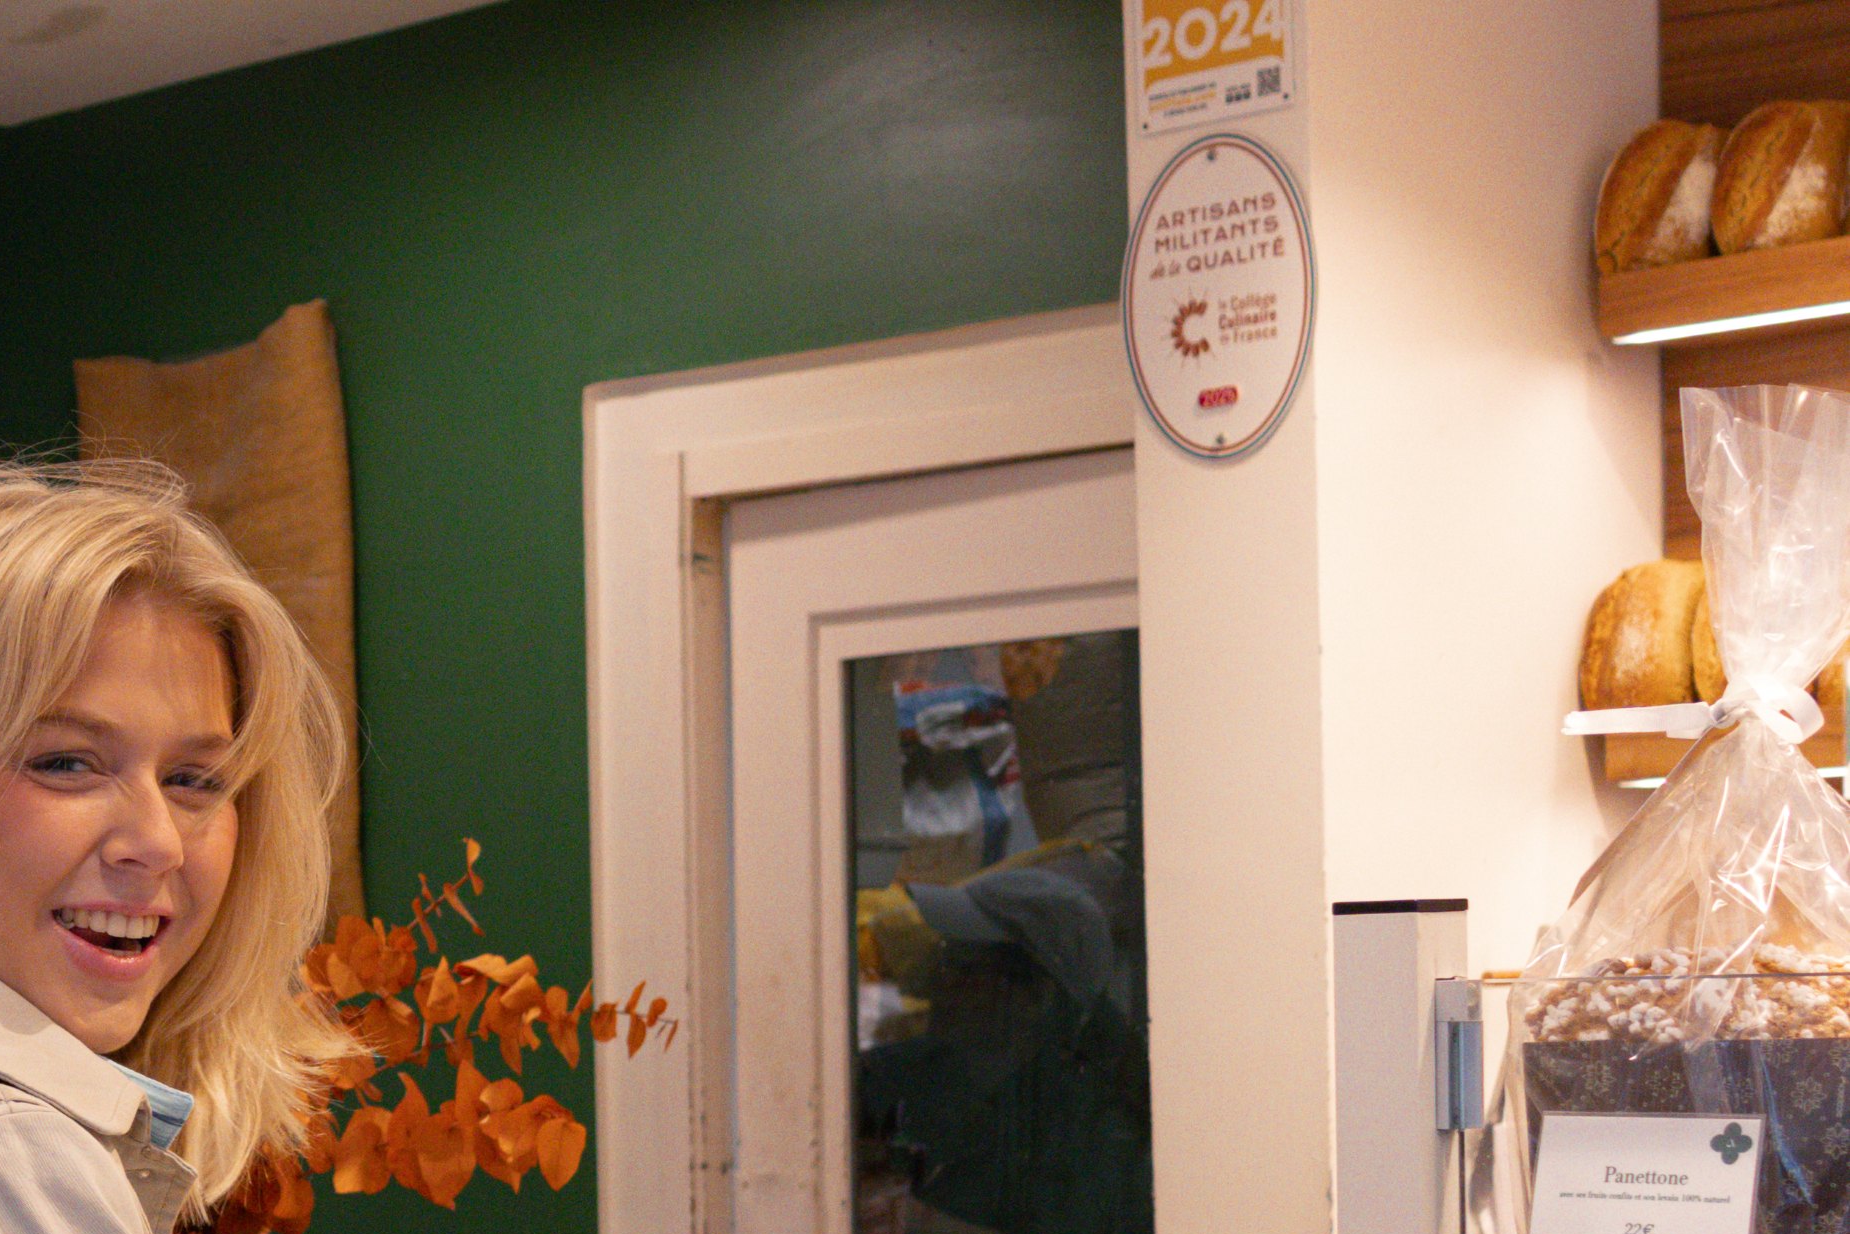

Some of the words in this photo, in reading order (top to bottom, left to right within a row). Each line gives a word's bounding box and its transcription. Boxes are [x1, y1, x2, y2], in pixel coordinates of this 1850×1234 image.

[1143, 0, 1282, 68] 2024
[1156, 192, 1276, 230] ARTISANS
[1155, 215, 1279, 253] MILITANTS
[1186, 235, 1285, 272] QUALITÉ
[1604, 1166, 1688, 1186] Panettone
[1682, 1194, 1701, 1203] 100%
